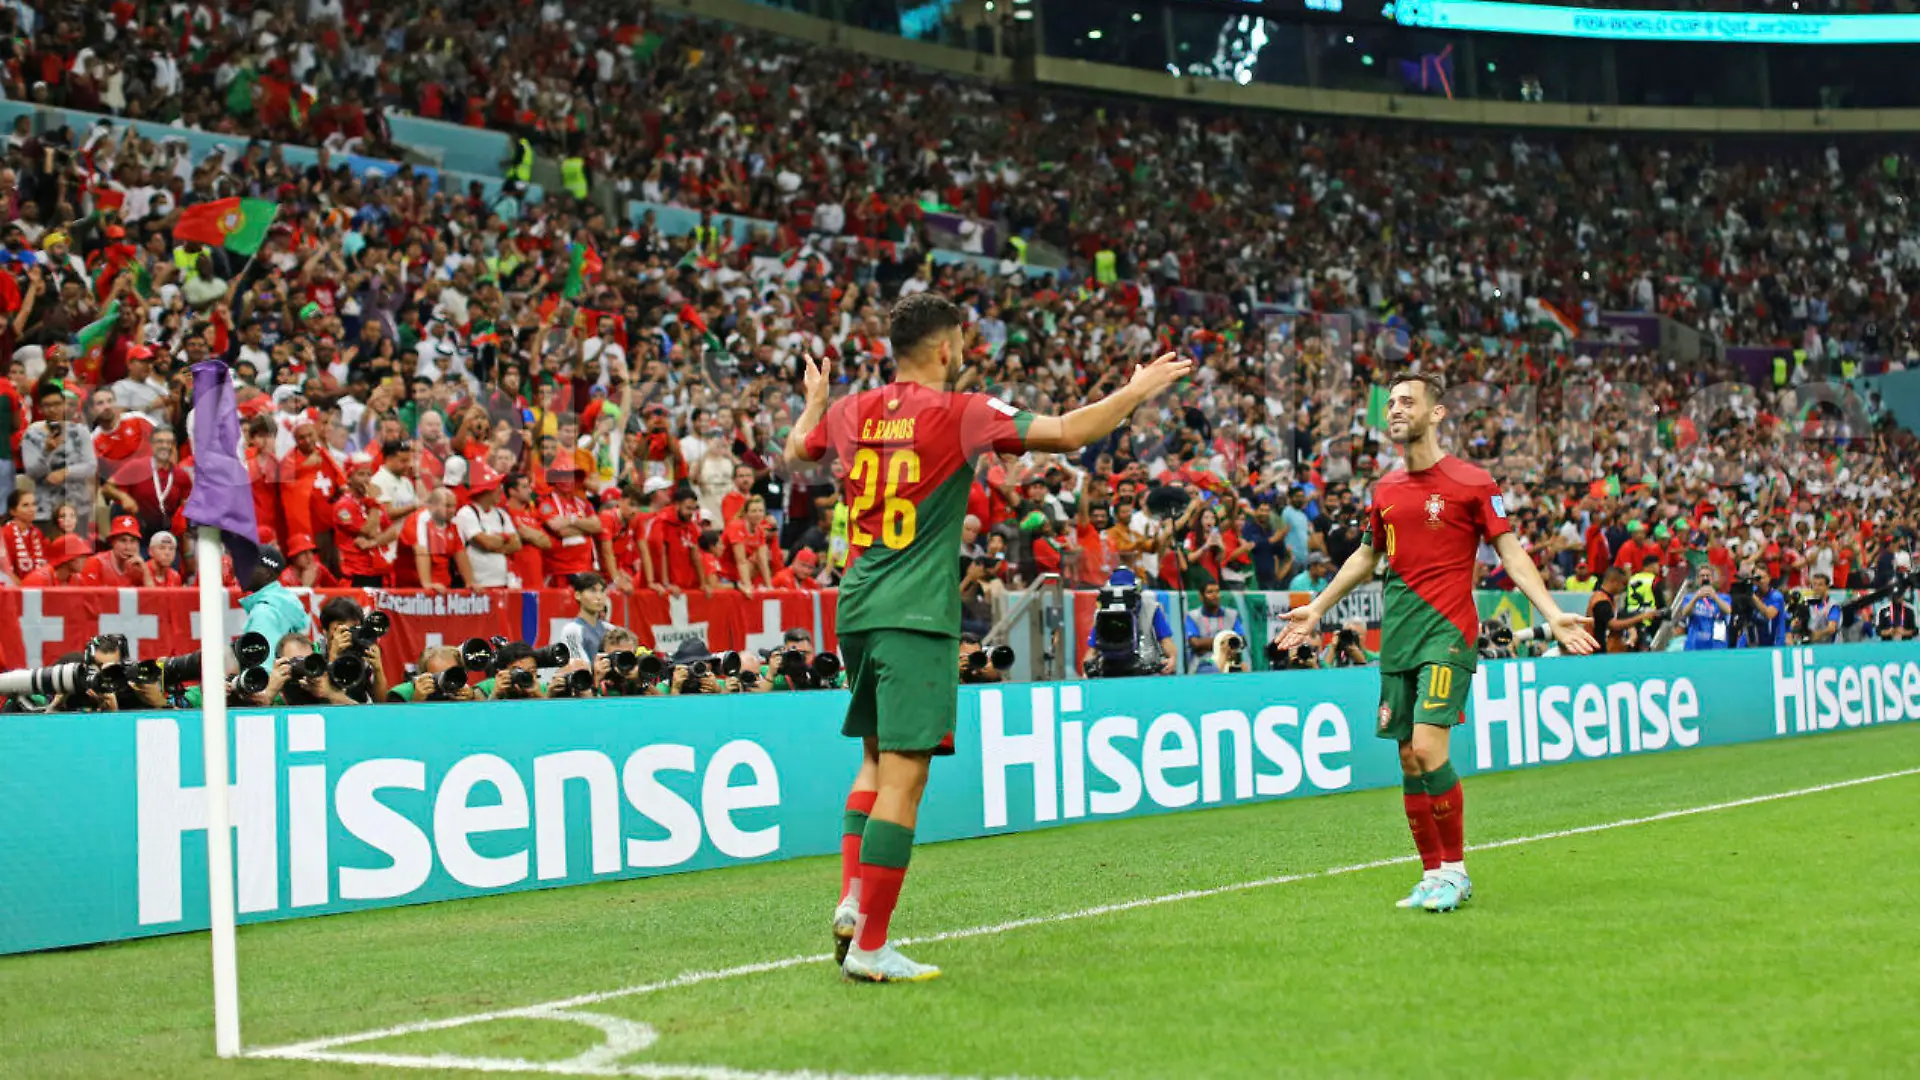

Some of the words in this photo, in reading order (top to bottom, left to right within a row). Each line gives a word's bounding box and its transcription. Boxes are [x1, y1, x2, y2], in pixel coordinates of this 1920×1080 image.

[848, 447, 921, 550] 26
[434, 595, 446, 616] &
[1428, 663, 1453, 699] 10
[1473, 661, 1701, 769] Hisense
[1772, 647, 1920, 735] Hisense
[137, 713, 781, 926] Hisense
[980, 685, 1352, 828] Hisense
